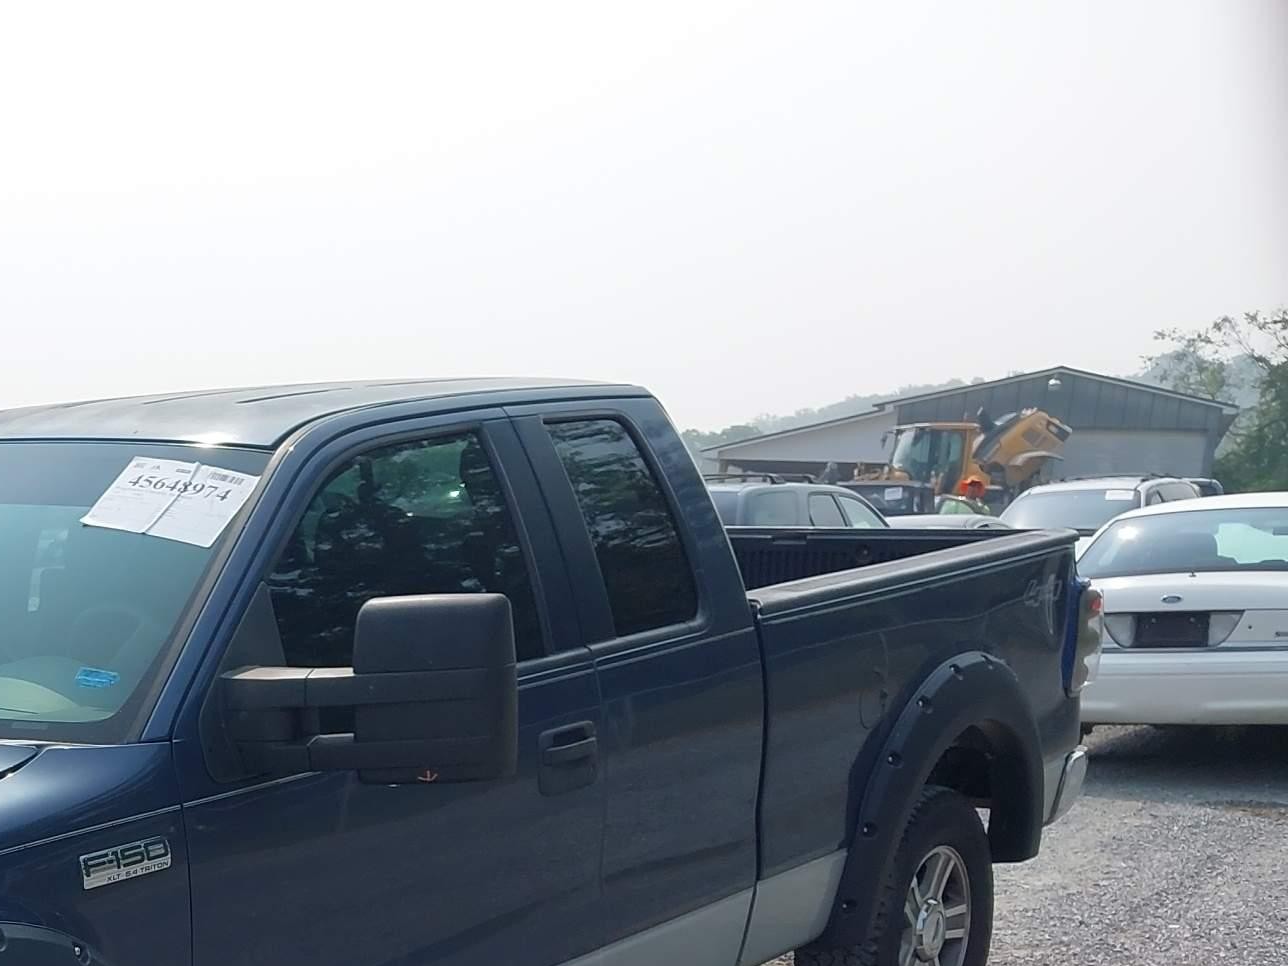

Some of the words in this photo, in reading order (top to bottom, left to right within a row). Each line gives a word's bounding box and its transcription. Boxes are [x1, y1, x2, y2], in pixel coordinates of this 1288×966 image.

[128, 473, 233, 502] 45648974
[106, 873, 121, 882] XLT
[140, 861, 169, 873] TRITON
